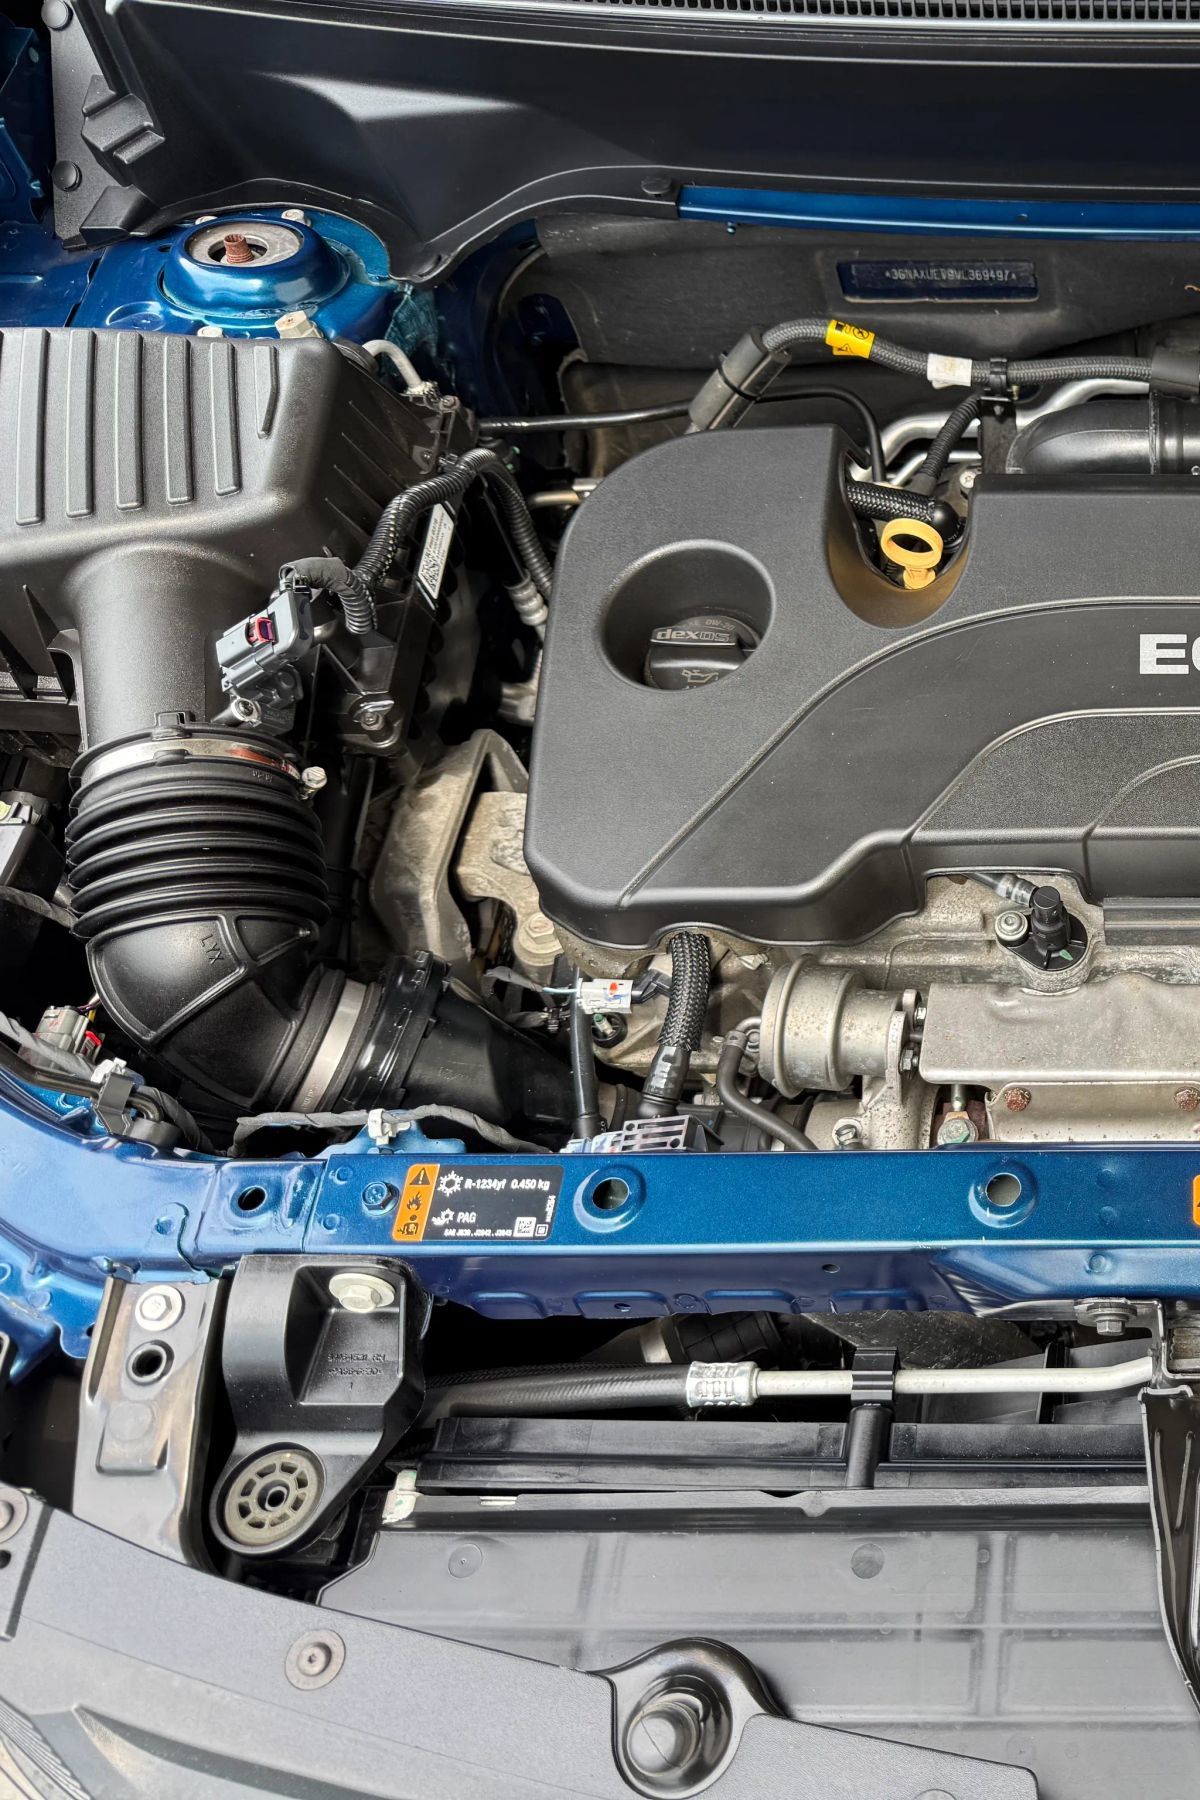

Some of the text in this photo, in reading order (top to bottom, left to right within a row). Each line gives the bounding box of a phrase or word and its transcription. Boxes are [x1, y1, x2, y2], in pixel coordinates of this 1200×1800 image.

[656, 628, 730, 642] dexos
[464, 1178, 550, 1191] R-1234yf 0.450 kg
[456, 1212, 477, 1224] PAG
